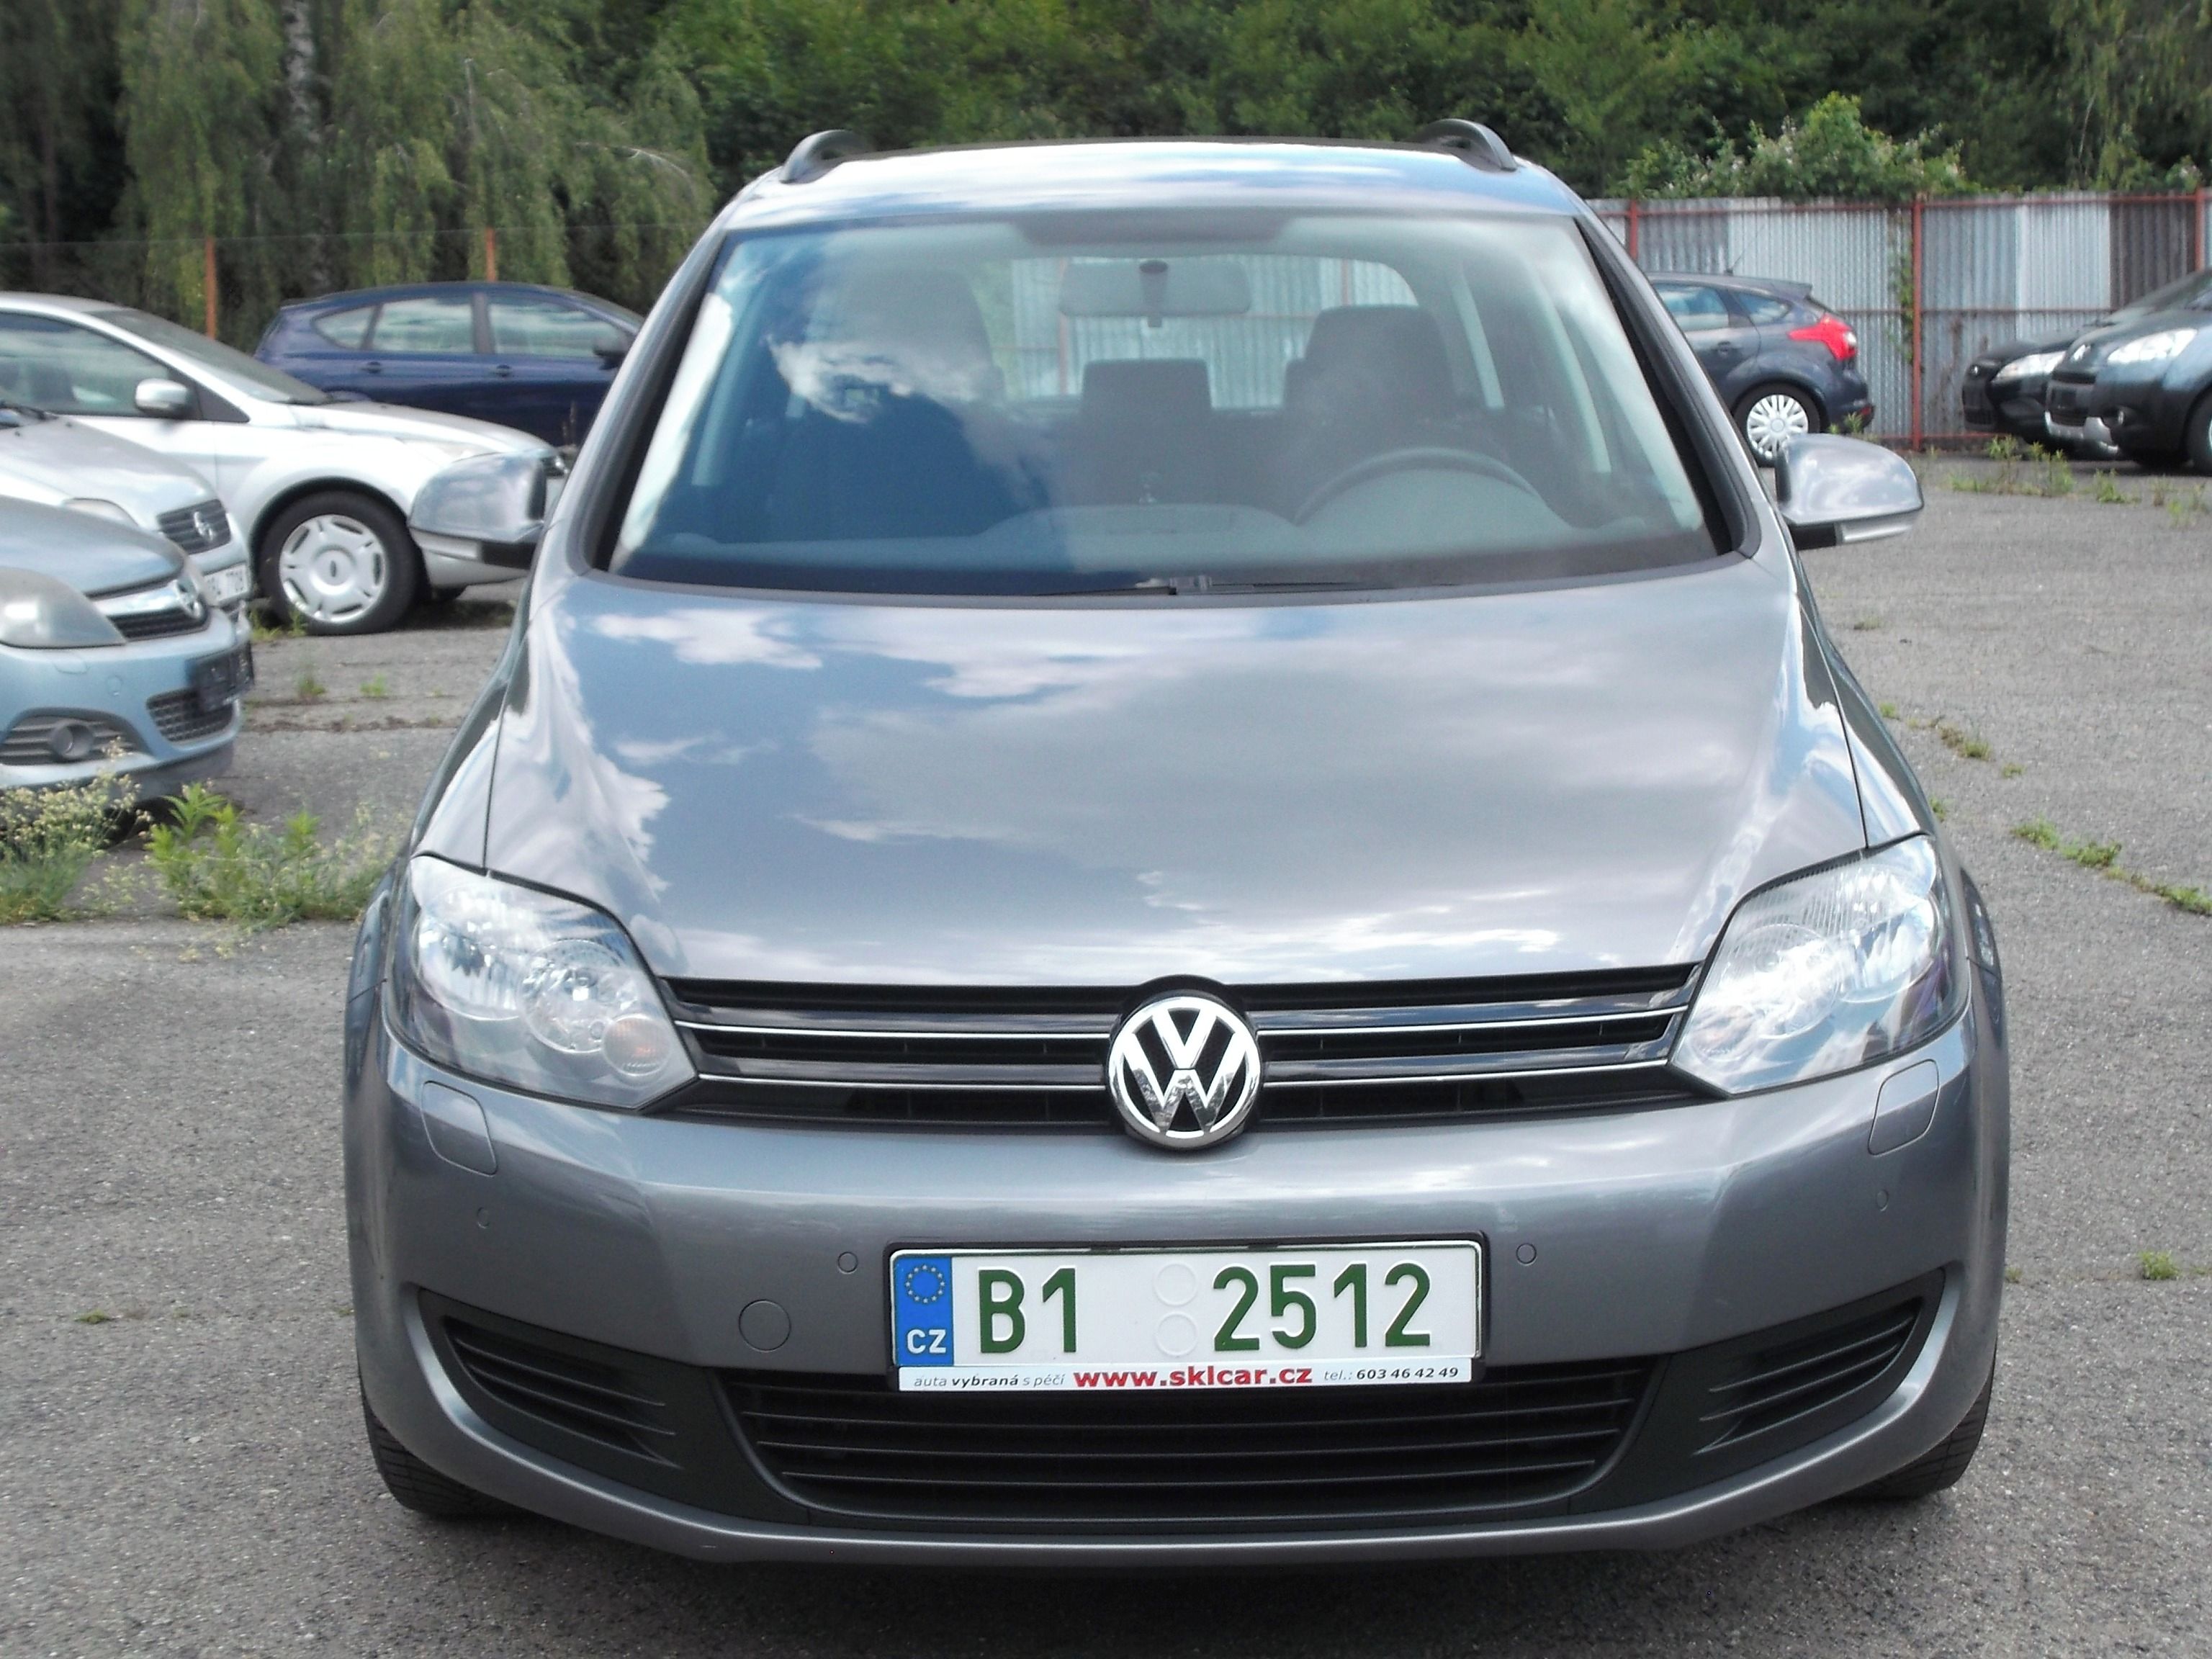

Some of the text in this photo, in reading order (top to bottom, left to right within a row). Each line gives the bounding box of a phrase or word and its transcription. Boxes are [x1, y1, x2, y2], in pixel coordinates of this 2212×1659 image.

[979, 1263, 1431, 1354] B1 2512
[907, 1329, 947, 1354] CZ
[914, 1372, 1066, 1388] auta vybraná s péčí
[1073, 1365, 1313, 1388] www.sklcar.cz
[1323, 1367, 1458, 1381] tel.: 603 46 42 49
